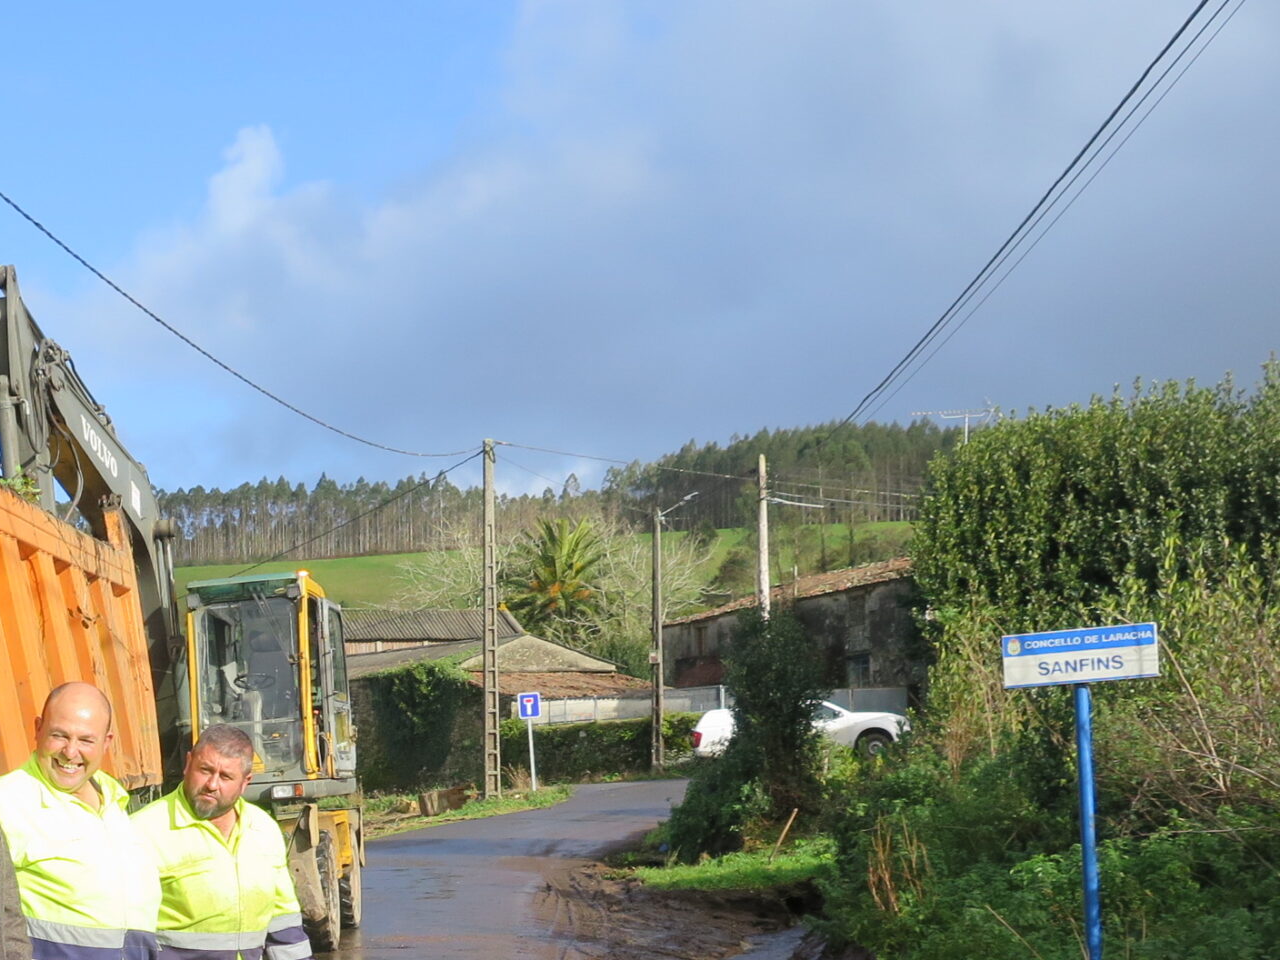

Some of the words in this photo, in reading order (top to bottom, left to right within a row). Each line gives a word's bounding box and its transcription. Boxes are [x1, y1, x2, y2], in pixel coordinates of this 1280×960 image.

[81, 414, 118, 479] VOLVO
[1024, 636, 1081, 649] CONCELLO
[1084, 633, 1099, 644] DE
[1102, 630, 1152, 642] LARACHA
[1038, 655, 1124, 676] SANFINS
